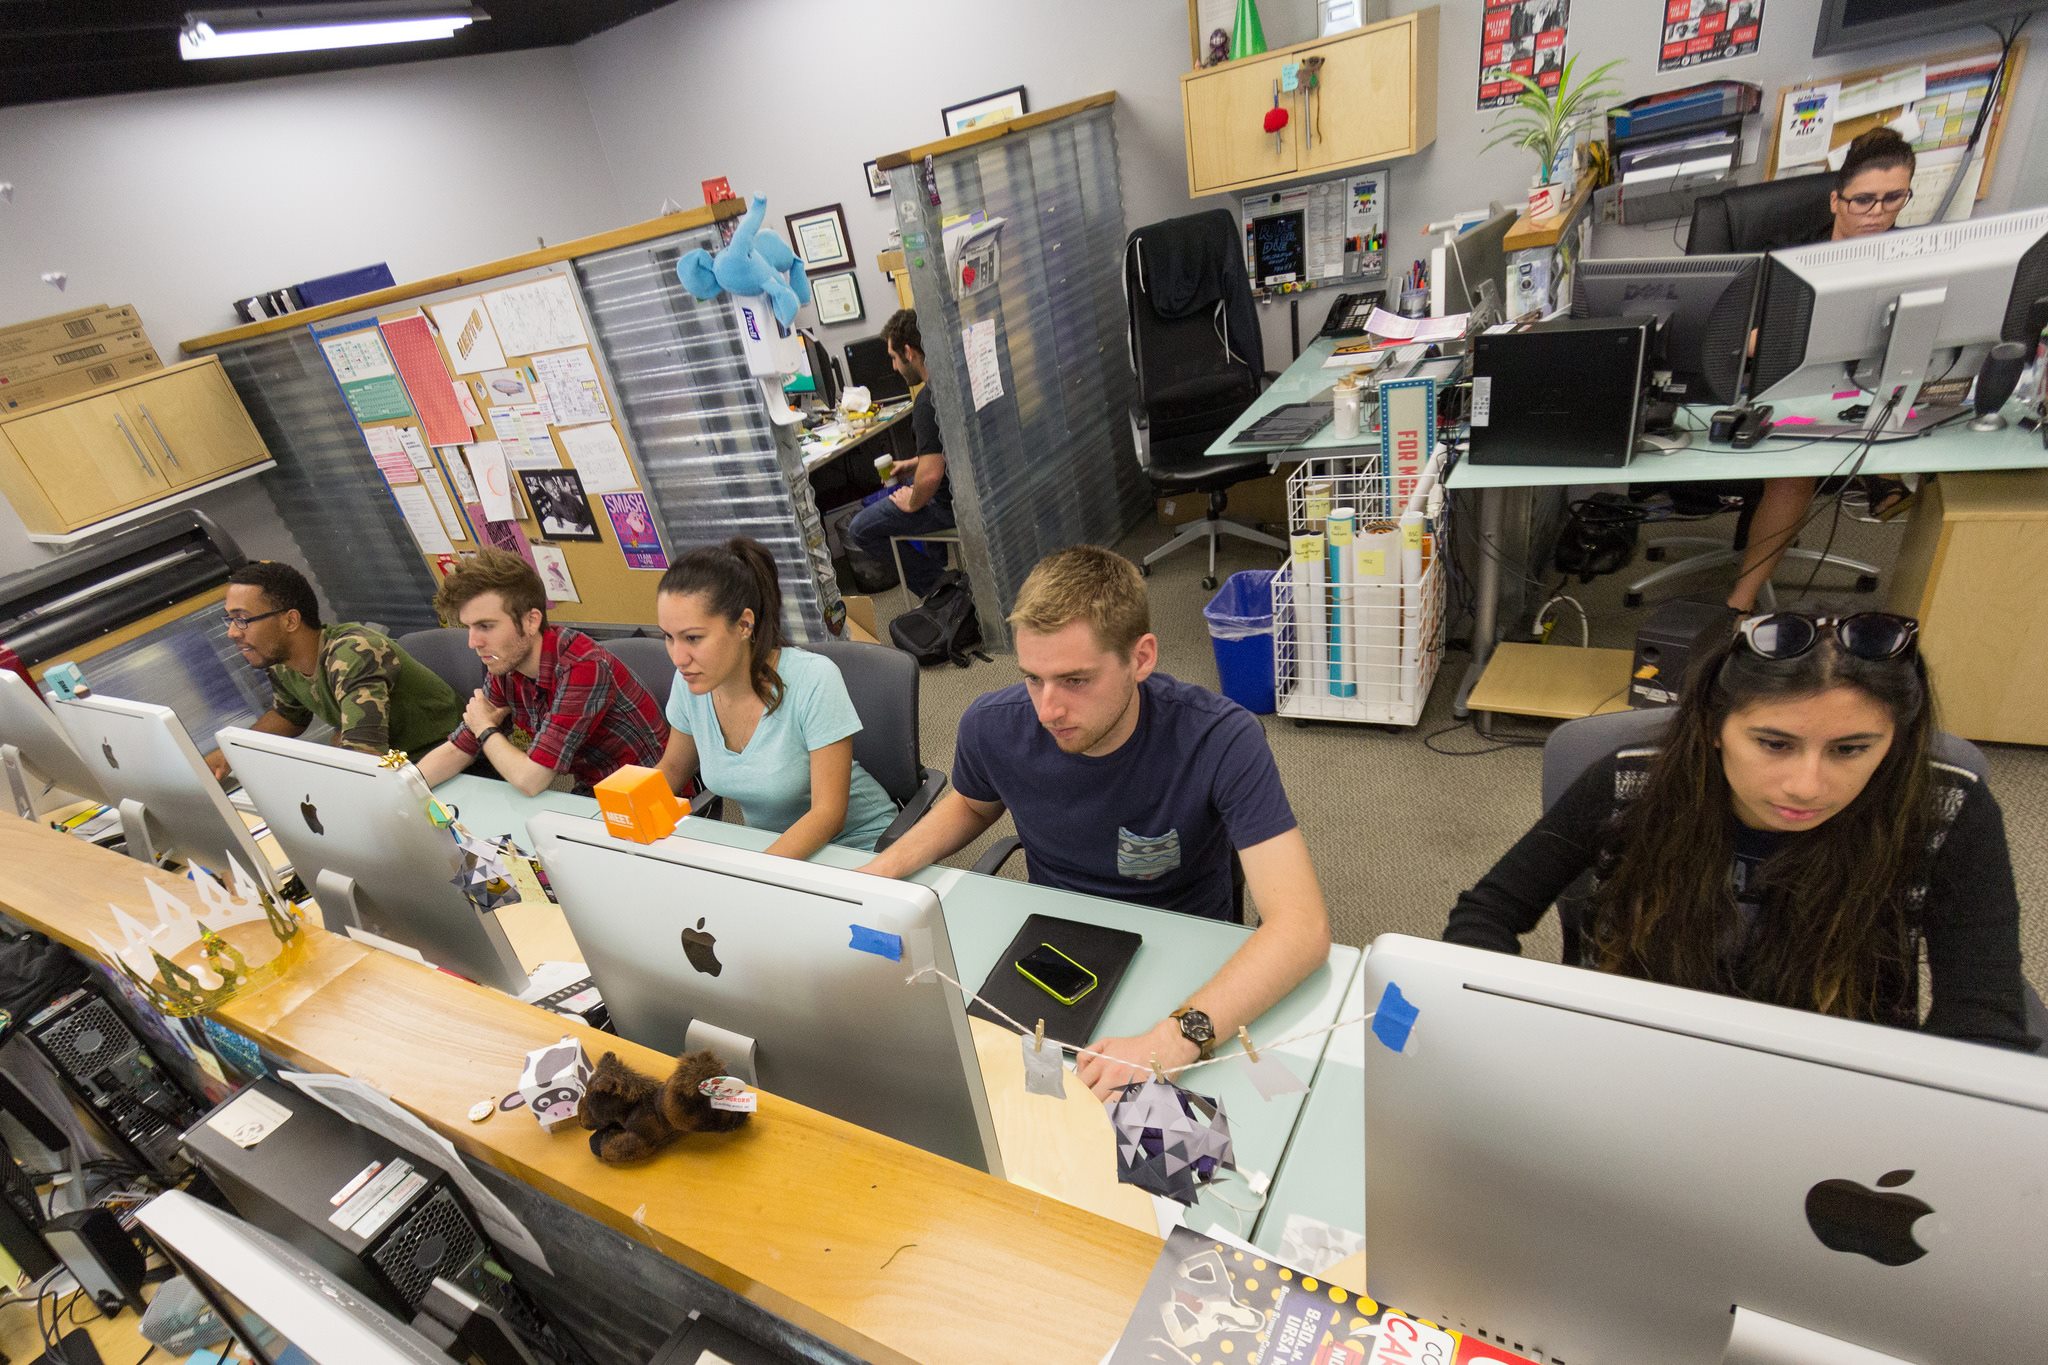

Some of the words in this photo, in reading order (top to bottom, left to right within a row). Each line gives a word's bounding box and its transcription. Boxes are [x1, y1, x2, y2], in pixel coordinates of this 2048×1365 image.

[1397, 430, 1418, 461] FOR
[604, 494, 646, 514] SMASH
[605, 811, 634, 826] MEET.
[1276, 1314, 1302, 1354] URSA
